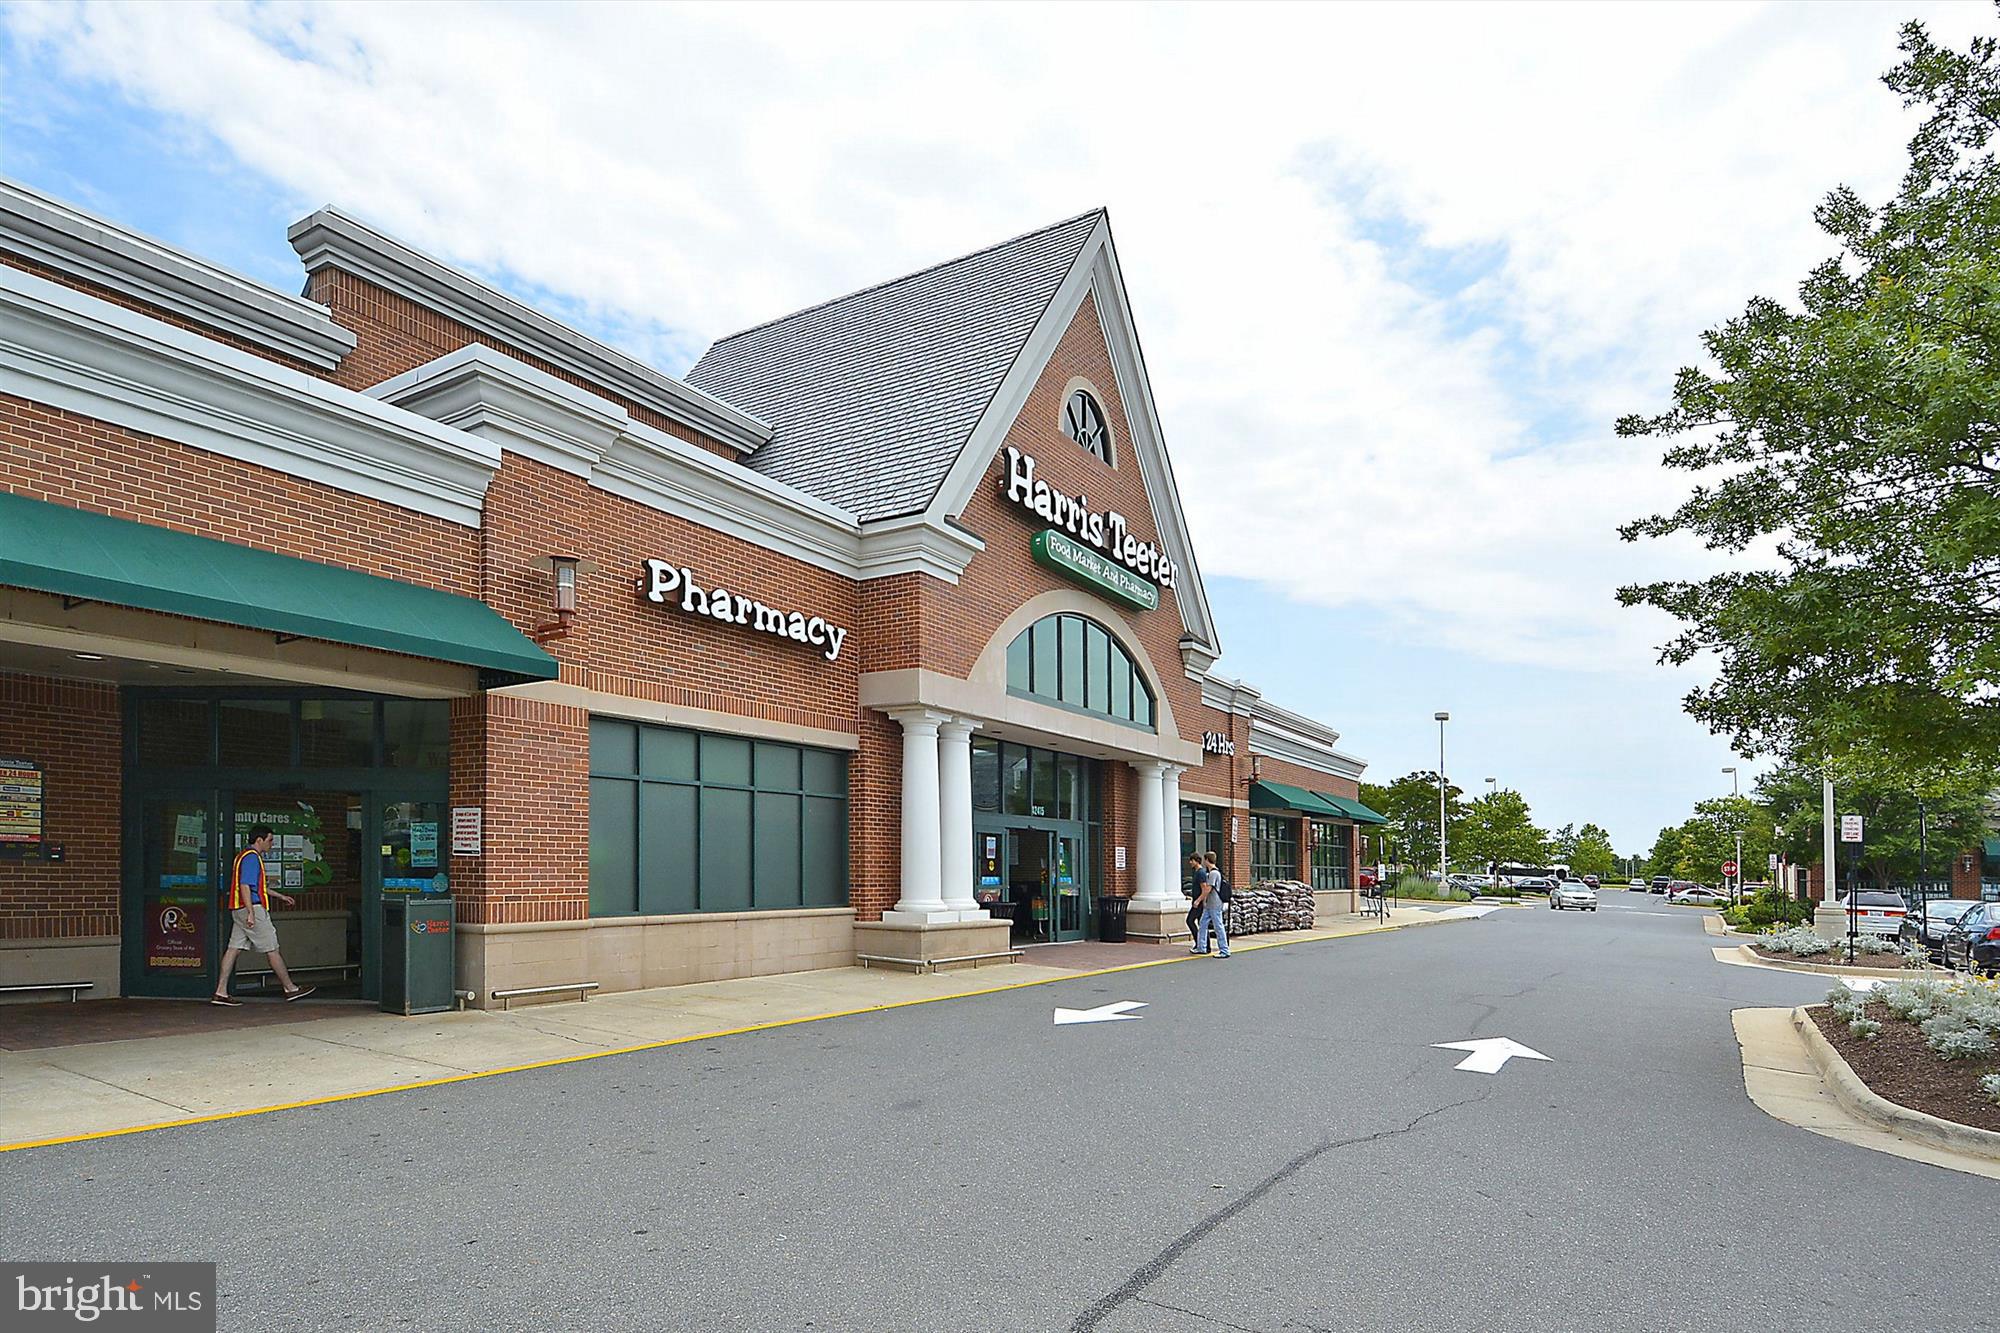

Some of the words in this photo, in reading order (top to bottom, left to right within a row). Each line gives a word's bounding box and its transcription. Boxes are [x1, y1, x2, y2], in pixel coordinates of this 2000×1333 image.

[1008, 446, 1104, 548] Harris
[1109, 511, 1179, 589] Teeter
[1050, 536, 1072, 559] Food
[1072, 548, 1102, 575] Market
[1102, 565, 1120, 586] And
[1120, 575, 1156, 605] Pharmacy
[648, 558, 847, 661] Pharmacy
[1206, 731, 1218, 753] 24
[1218, 732, 1235, 757] Hrs
[259, 811, 290, 824] Cares
[177, 834, 200, 849] FREE
